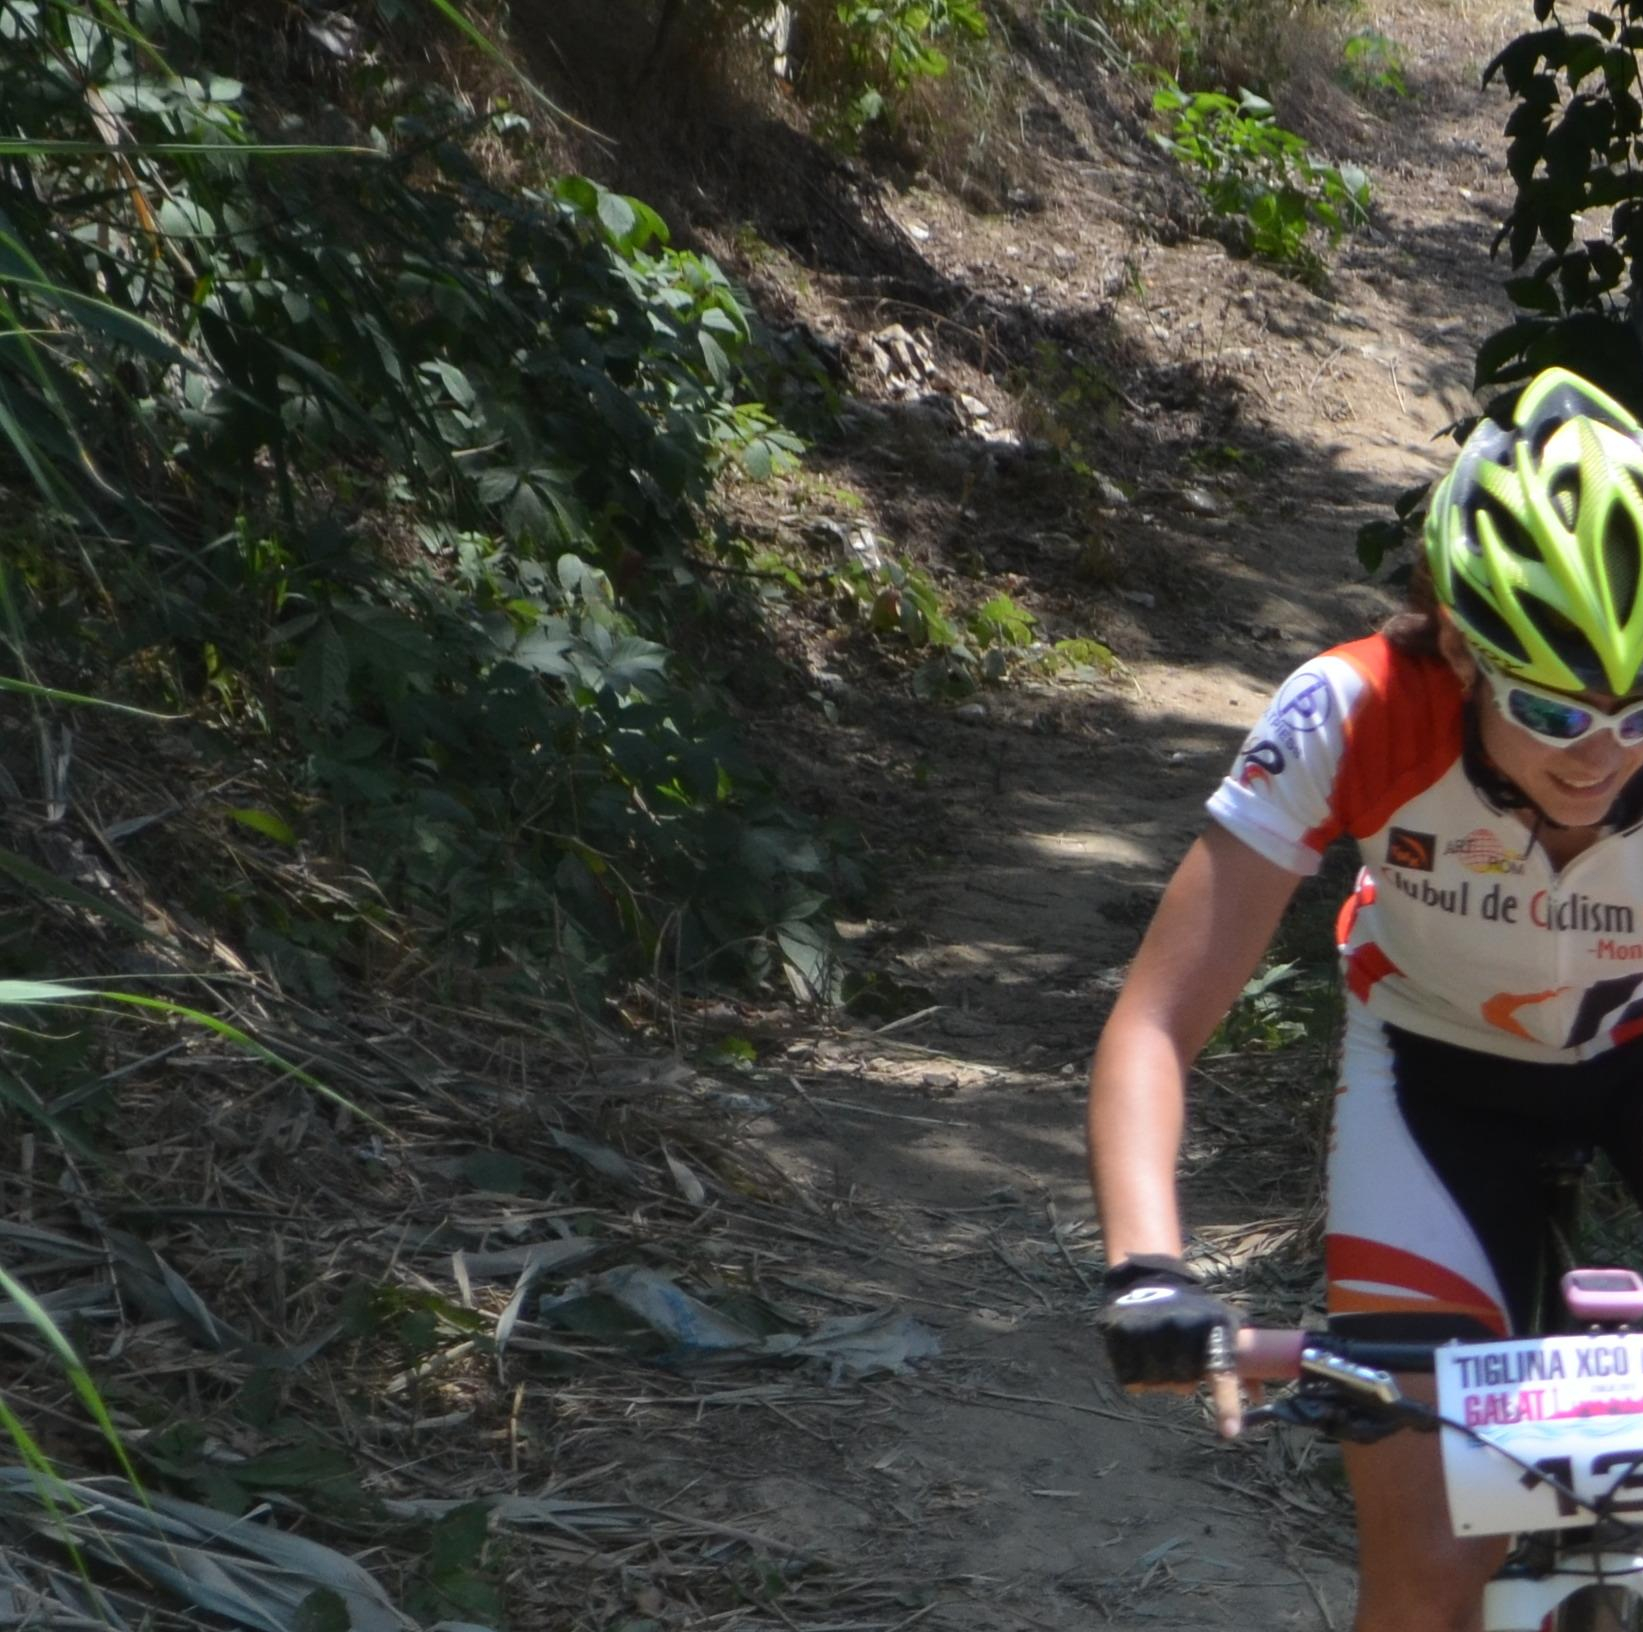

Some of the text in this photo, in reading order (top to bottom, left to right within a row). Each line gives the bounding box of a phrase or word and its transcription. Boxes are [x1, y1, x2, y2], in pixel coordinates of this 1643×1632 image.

[1481, 883, 1518, 924] de
[1529, 889, 1635, 934] Ciclism
[1453, 1348, 1566, 1389] TIGLINA
[1577, 1345, 1629, 1378] XCO
